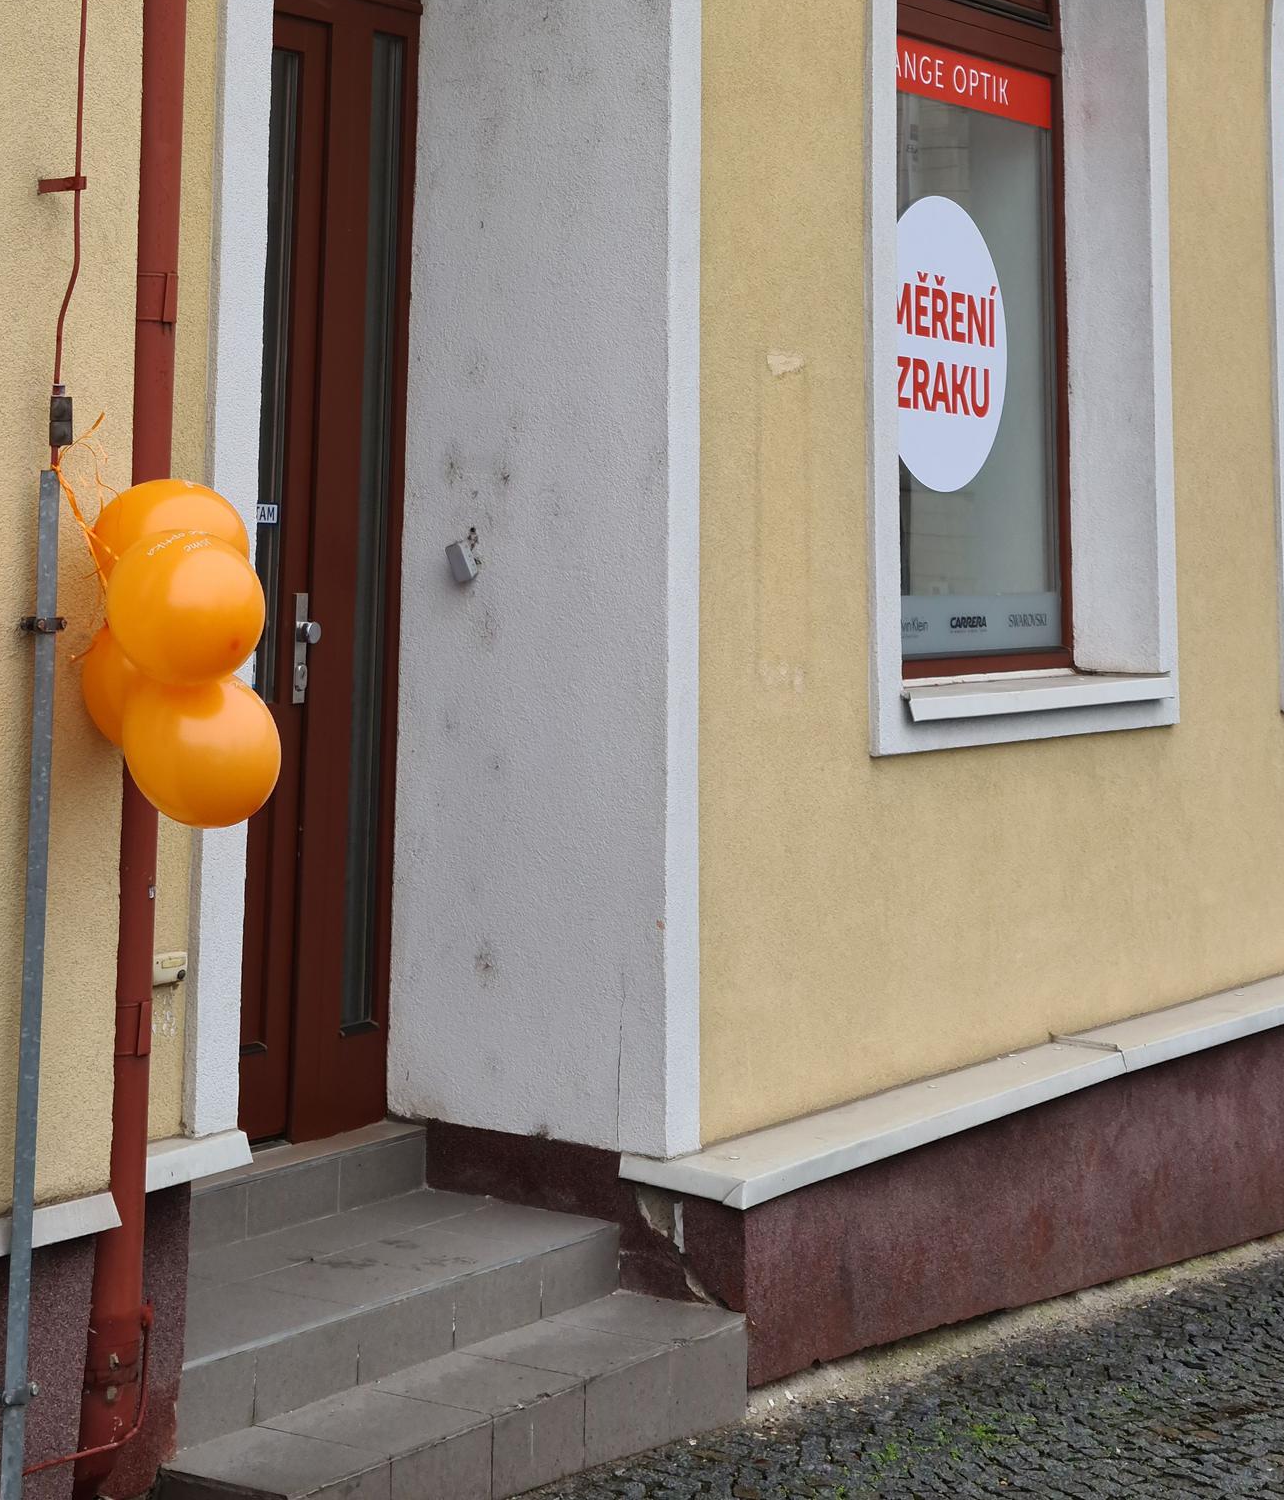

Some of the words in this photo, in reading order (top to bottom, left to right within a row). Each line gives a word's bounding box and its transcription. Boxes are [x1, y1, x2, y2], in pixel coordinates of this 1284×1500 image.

[953, 65, 1009, 105] OPTIK
[897, 355, 990, 418] ZRAKU
[950, 616, 988, 629] CARRERA
[1008, 613, 1048, 628] SWAROVSKI
